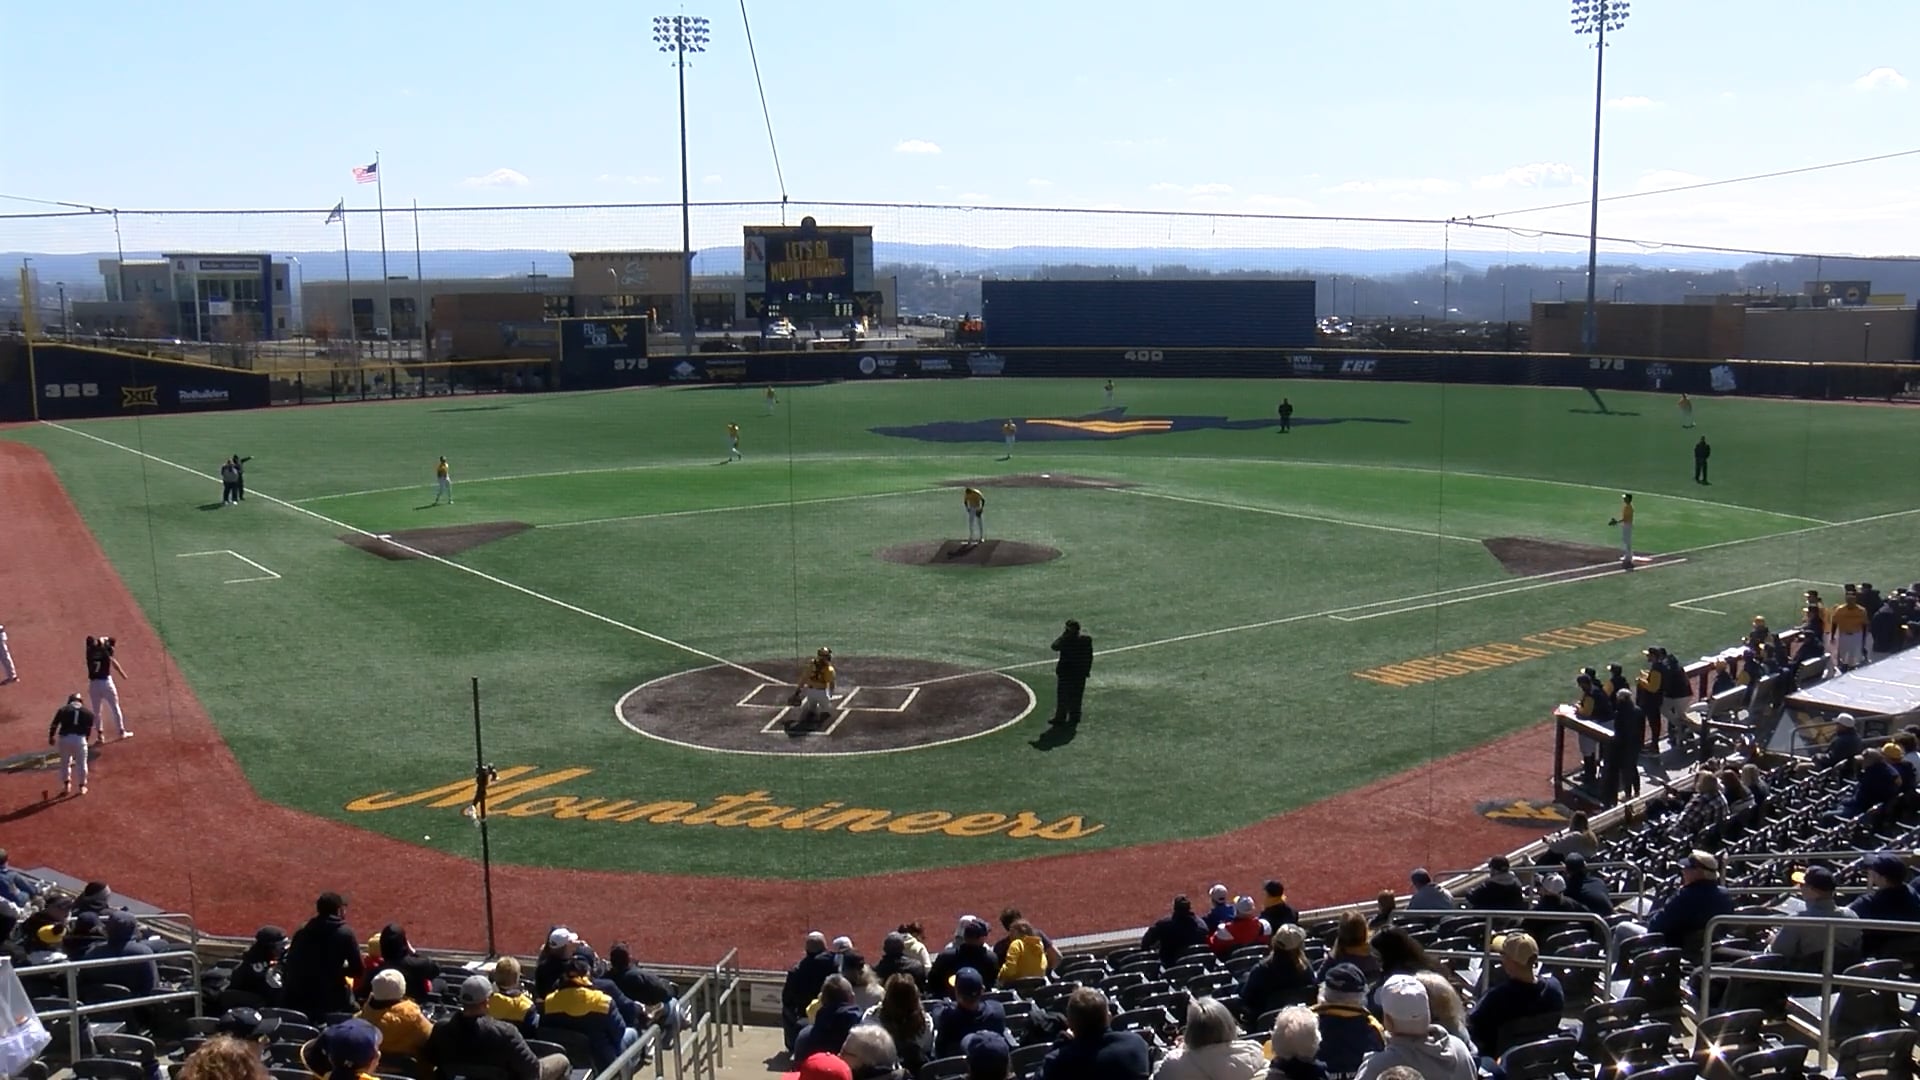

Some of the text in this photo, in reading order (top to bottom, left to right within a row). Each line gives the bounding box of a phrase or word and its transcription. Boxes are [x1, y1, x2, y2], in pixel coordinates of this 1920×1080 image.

[1124, 350, 1164, 361] 400
[614, 358, 649, 370] 375
[1589, 357, 1625, 370] 375
[45, 383, 98, 398] 325
[1521, 619, 1647, 649] FIELD
[94, 661, 101, 673] 7
[73, 709, 79, 726] 1
[346, 765, 1106, 840] Mountaineers
